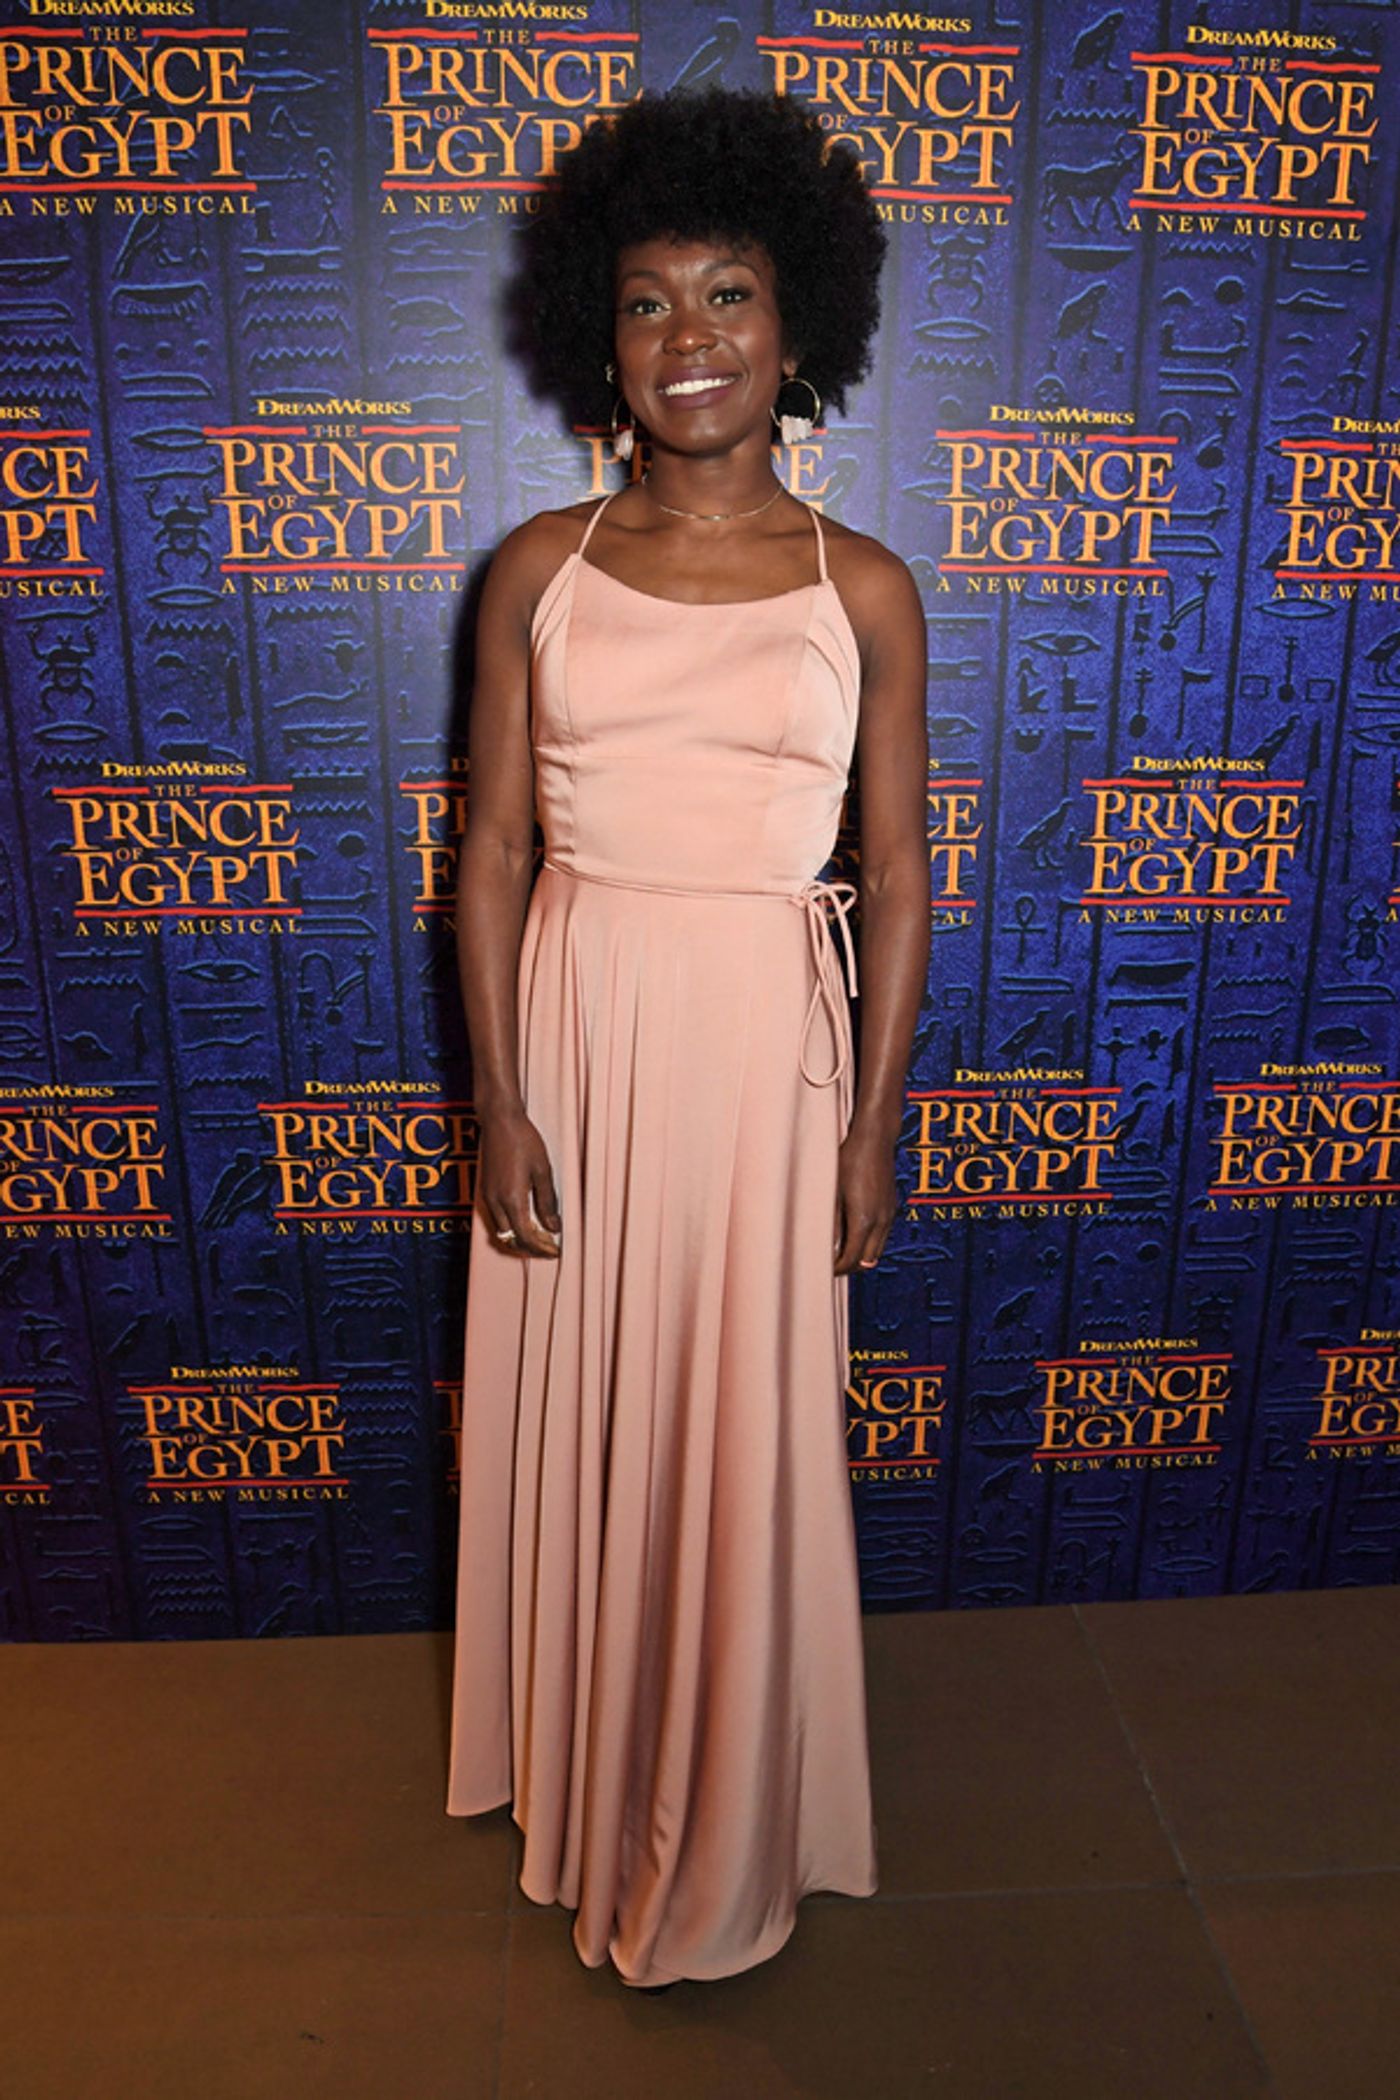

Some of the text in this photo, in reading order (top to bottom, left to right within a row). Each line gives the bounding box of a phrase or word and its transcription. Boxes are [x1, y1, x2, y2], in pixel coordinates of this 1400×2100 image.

[89, 26, 137, 41] THE
[483, 28, 530, 45] THE
[869, 40, 914, 56] THE
[1238, 56, 1281, 72] THE
[0, 42, 255, 107] PRINCE
[370, 42, 643, 108] PRINCE
[759, 49, 1021, 121] PRINCE
[1132, 65, 1379, 137] PRINCE
[45, 105, 76, 121] OF
[434, 105, 466, 122] OF
[817, 113, 848, 130] OF
[0, 109, 251, 178] EGYPT
[373, 109, 622, 178] EGYP
[1185, 129, 1214, 144] OF
[821, 121, 1013, 188] GYPT
[1128, 129, 1370, 204] EGYPT
[0, 196, 256, 216] A NEW MUSICAL
[381, 196, 397, 214] A
[414, 196, 482, 214] NEW
[876, 204, 1008, 225] MUSICAL
[1126, 214, 1362, 241] A NEW MUSICAL
[313, 424, 357, 438] THE
[1040, 431, 1081, 445] THE
[1378, 443, 1400, 455] TH
[206, 438, 465, 498] PRINCE
[938, 441, 1178, 502] PRINCE
[269, 494, 297, 510] OF
[991, 498, 1018, 513] OF
[1328, 506, 1354, 521] OF
[211, 499, 461, 559] EGYPT
[936, 501, 1170, 564] EGYPT
[1275, 508, 1400, 569] EGY
[0, 580, 103, 597] USICAL
[221, 575, 464, 594] A NEW MUSICAL
[936, 577, 1165, 596] A NEW MUSICAL
[1272, 583, 1286, 599] A
[1300, 583, 1357, 600] NEW
[154, 784, 197, 797] THE
[1178, 778, 1216, 790] THE
[56, 797, 300, 851] PRINCE
[1083, 790, 1303, 841] PRINCE
[1130, 837, 1156, 852] OF
[117, 847, 144, 861] OF
[1080, 840, 1295, 895] EGYPT
[62, 851, 298, 906] EGYPT
[1078, 908, 1288, 923] A NEW MUSICAL
[1385, 908, 1398, 923] A
[74, 918, 302, 936] A NEW MUSICAL
[413, 917, 427, 932] A
[0, 1084, 115, 1098] REAMWORKS
[1001, 1087, 1037, 1100] THE
[1301, 1081, 1336, 1092] THE
[29, 1106, 68, 1116] THE
[353, 1101, 394, 1112] THE
[1214, 1093, 1400, 1137] PRINCE
[909, 1100, 1123, 1146] PRINCE
[0, 1118, 167, 1162] RINCE
[261, 1112, 479, 1159] PRINCE
[1255, 1135, 1279, 1146] OF
[956, 1142, 980, 1156] OF
[315, 1155, 342, 1169] OF
[906, 1144, 1116, 1194] EGYPT
[1209, 1137, 1400, 1185] EGYPT
[0, 1164, 164, 1212] GYPT
[265, 1160, 477, 1208] EGYPT
[1204, 1192, 1397, 1211] A NEW MUSICAL
[905, 1202, 1110, 1221] A NEW MUSICAL
[5, 1223, 172, 1238] EW MUSICAL
[275, 1222, 289, 1236] A
[303, 1220, 357, 1235] NEW
[1120, 1354, 1153, 1366] THE
[218, 1383, 254, 1395] THE
[1035, 1364, 1232, 1408] PRINCE
[1354, 1392, 1376, 1402] OF
[131, 1394, 347, 1436] PRINCE
[1078, 1403, 1101, 1416] OF
[1032, 1404, 1224, 1451] EGYPT
[183, 1432, 206, 1445] OF
[140, 1435, 345, 1480] EGYPT
[1305, 1448, 1318, 1460] A
[1329, 1446, 1376, 1459] NEW
[1030, 1453, 1218, 1474] A NEW MUSICAL
[851, 1466, 937, 1482] USICAL
[147, 1486, 349, 1503] A NEW MUSICAL
